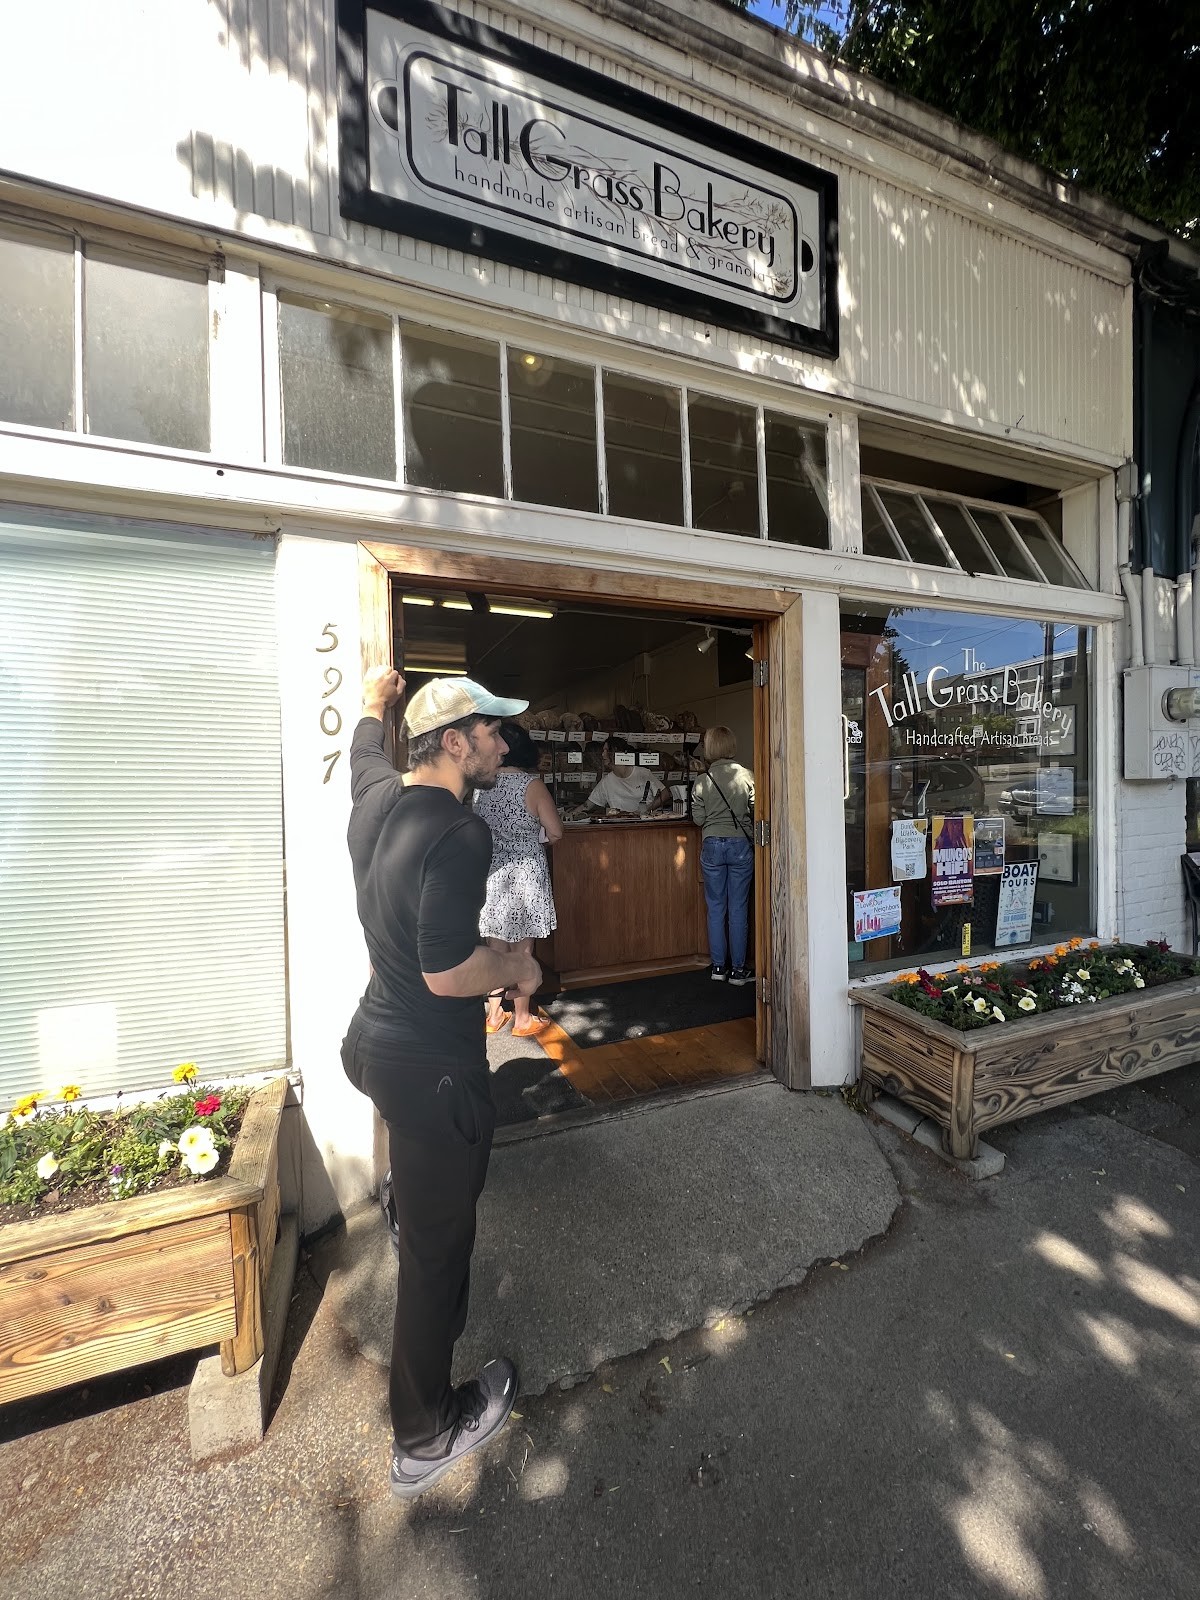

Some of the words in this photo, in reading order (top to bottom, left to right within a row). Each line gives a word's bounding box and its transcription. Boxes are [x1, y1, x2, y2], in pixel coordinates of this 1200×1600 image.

[431, 76, 511, 165] Tall
[519, 118, 644, 212] Grass
[653, 162, 775, 268] Bakery
[455, 155, 555, 211] handmade
[563, 205, 626, 235] artisan
[632, 217, 678, 253] bread
[686, 236, 701, 260] &
[707, 259, 766, 282] granola
[961, 647, 986, 672] The
[869, 671, 922, 728] Tall
[926, 665, 999, 708] Grass
[1002, 666, 1072, 739] Bakery
[906, 726, 976, 746] Handcrafted
[980, 730, 1019, 746] Artisan
[1022, 731, 1054, 748] Breads
[1001, 877, 1035, 888] TOURS
[1003, 863, 1037, 879] BOAT
